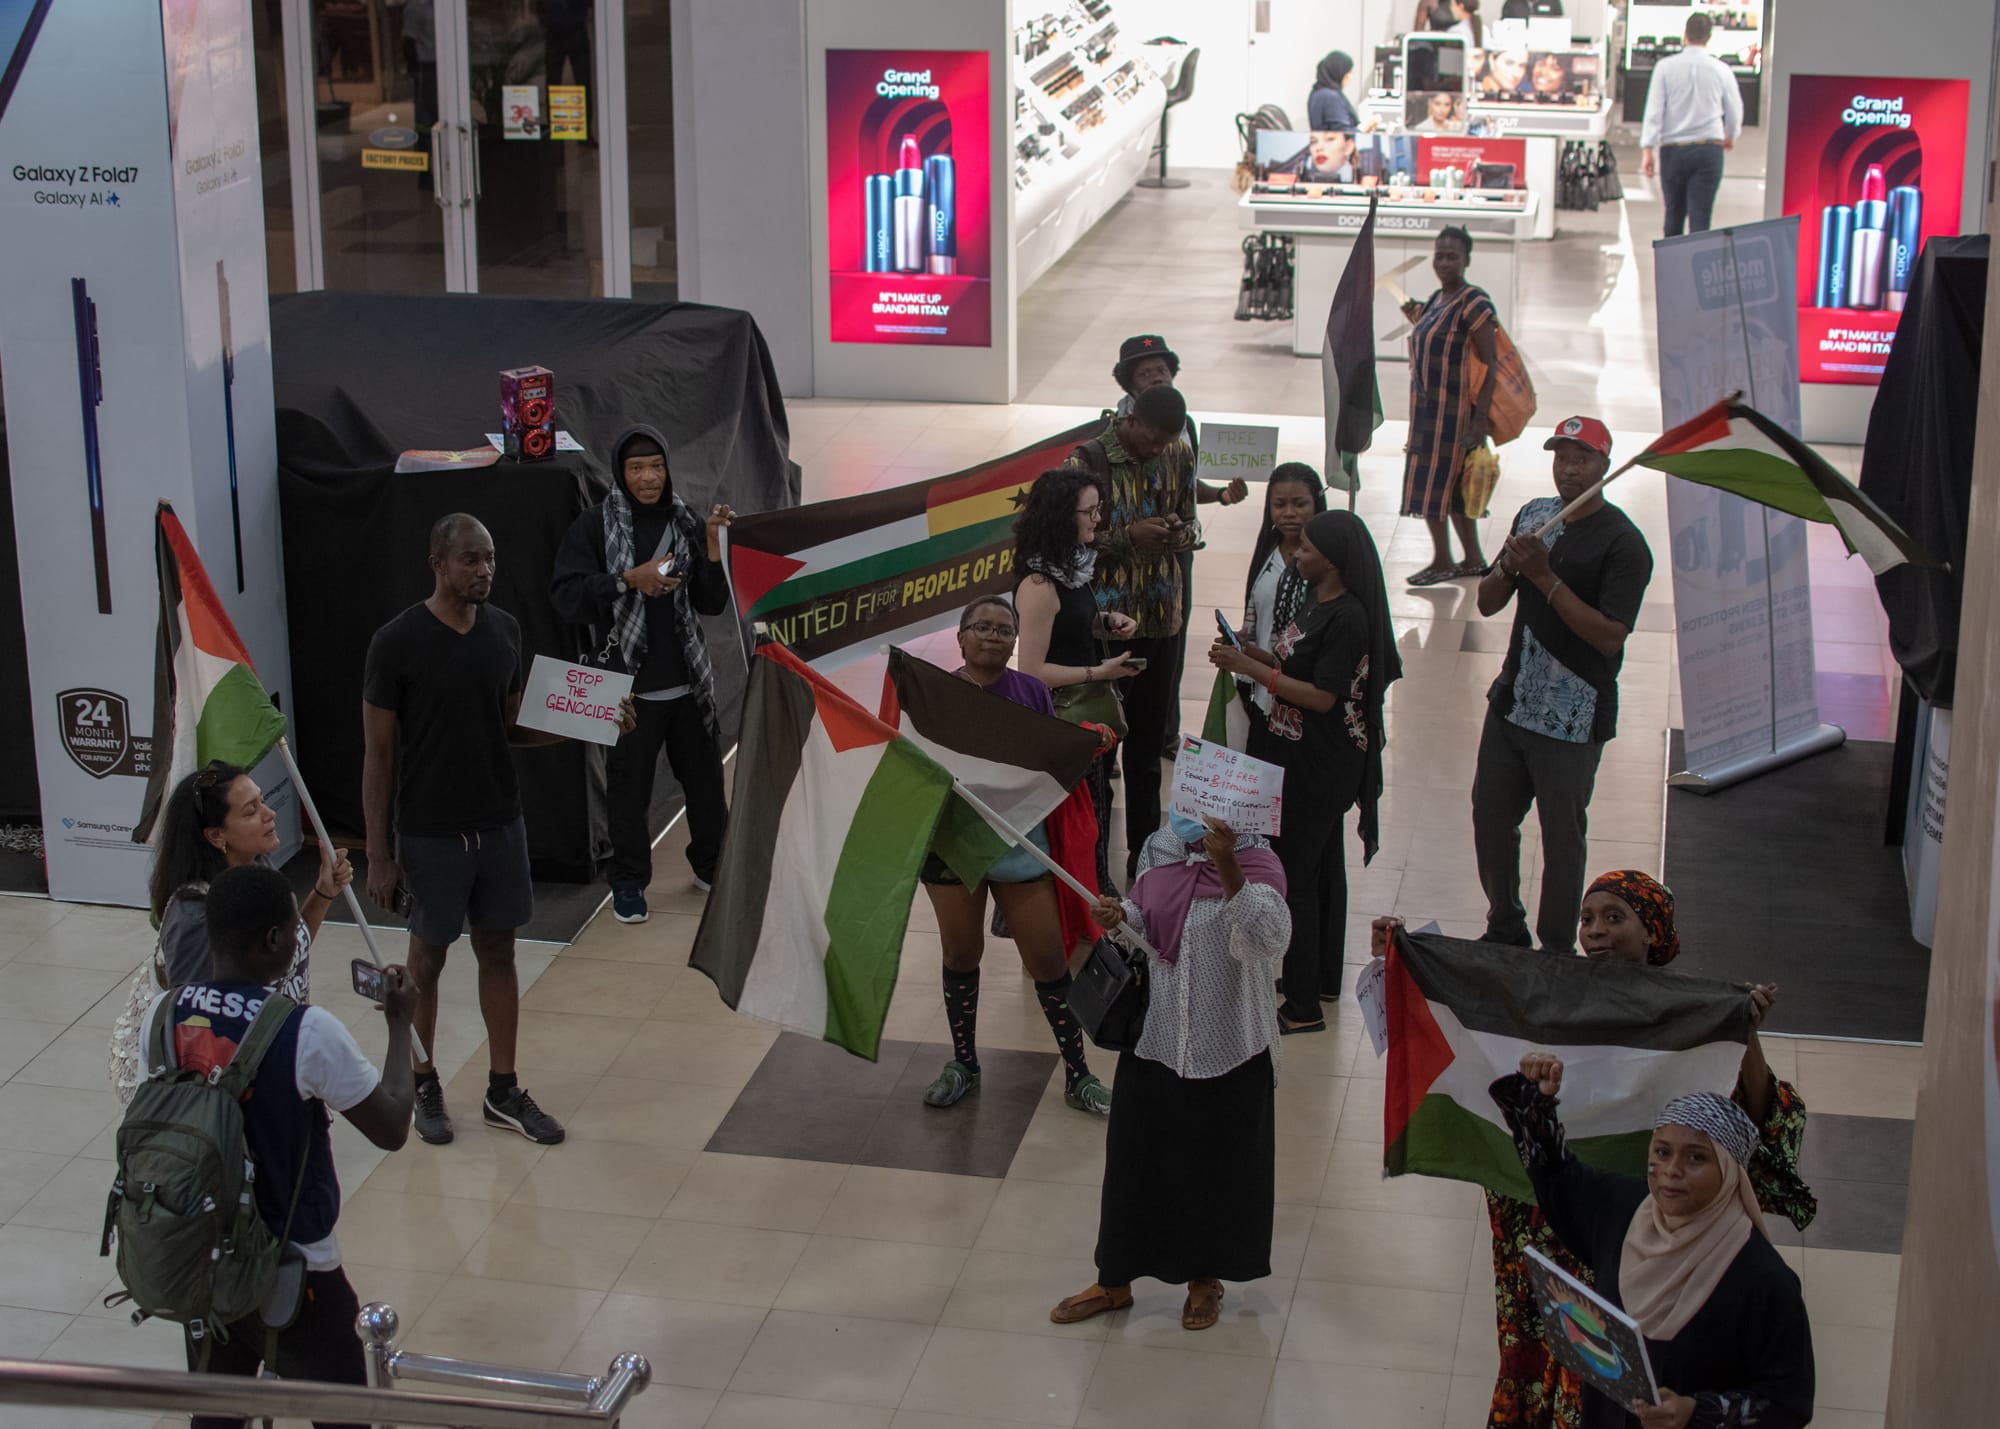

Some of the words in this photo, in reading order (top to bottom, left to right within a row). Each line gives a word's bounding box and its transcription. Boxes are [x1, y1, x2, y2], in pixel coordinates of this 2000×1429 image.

[884, 69, 931, 84] Grand
[876, 82, 939, 100] Opening
[1851, 95, 1903, 112] Grand
[1842, 108, 1911, 128] Opening
[13, 165, 76, 186] Galaxy
[79, 167, 89, 182] Z
[92, 167, 138, 183] Fold7
[34, 191, 86, 208] Galaxy
[90, 192, 103, 205] AI
[936, 210, 945, 242] KIKO
[1405, 218, 1430, 229] OUT
[1896, 245, 1907, 278] KIKO
[898, 293, 926, 304] MAKE
[927, 294, 942, 304] UP
[872, 303, 906, 314] BRAND
[907, 304, 919, 315] IN
[921, 305, 949, 316] ITALY
[1849, 330, 1879, 342] MAKE
[1820, 340, 1857, 352] BRAND
[1858, 341, 1871, 353] IN
[1872, 343, 1892, 354] ITA
[1218, 431, 1257, 446] FREE
[767, 602, 848, 646] NITED
[902, 568, 968, 607] PEOPLE
[972, 557, 995, 584] OF
[998, 547, 1015, 575] PA
[566, 669, 604, 687] STOP
[568, 685, 588, 698] THE
[75, 698, 112, 727] 24
[546, 694, 616, 721] GENOCIDE
[75, 727, 115, 738] MONTH
[70, 736, 120, 750] WARRANTY
[92, 754, 113, 762] AFRICA
[1180, 783, 1198, 796] END
[77, 820, 111, 833] Samsung
[177, 985, 264, 1021] PRESS
